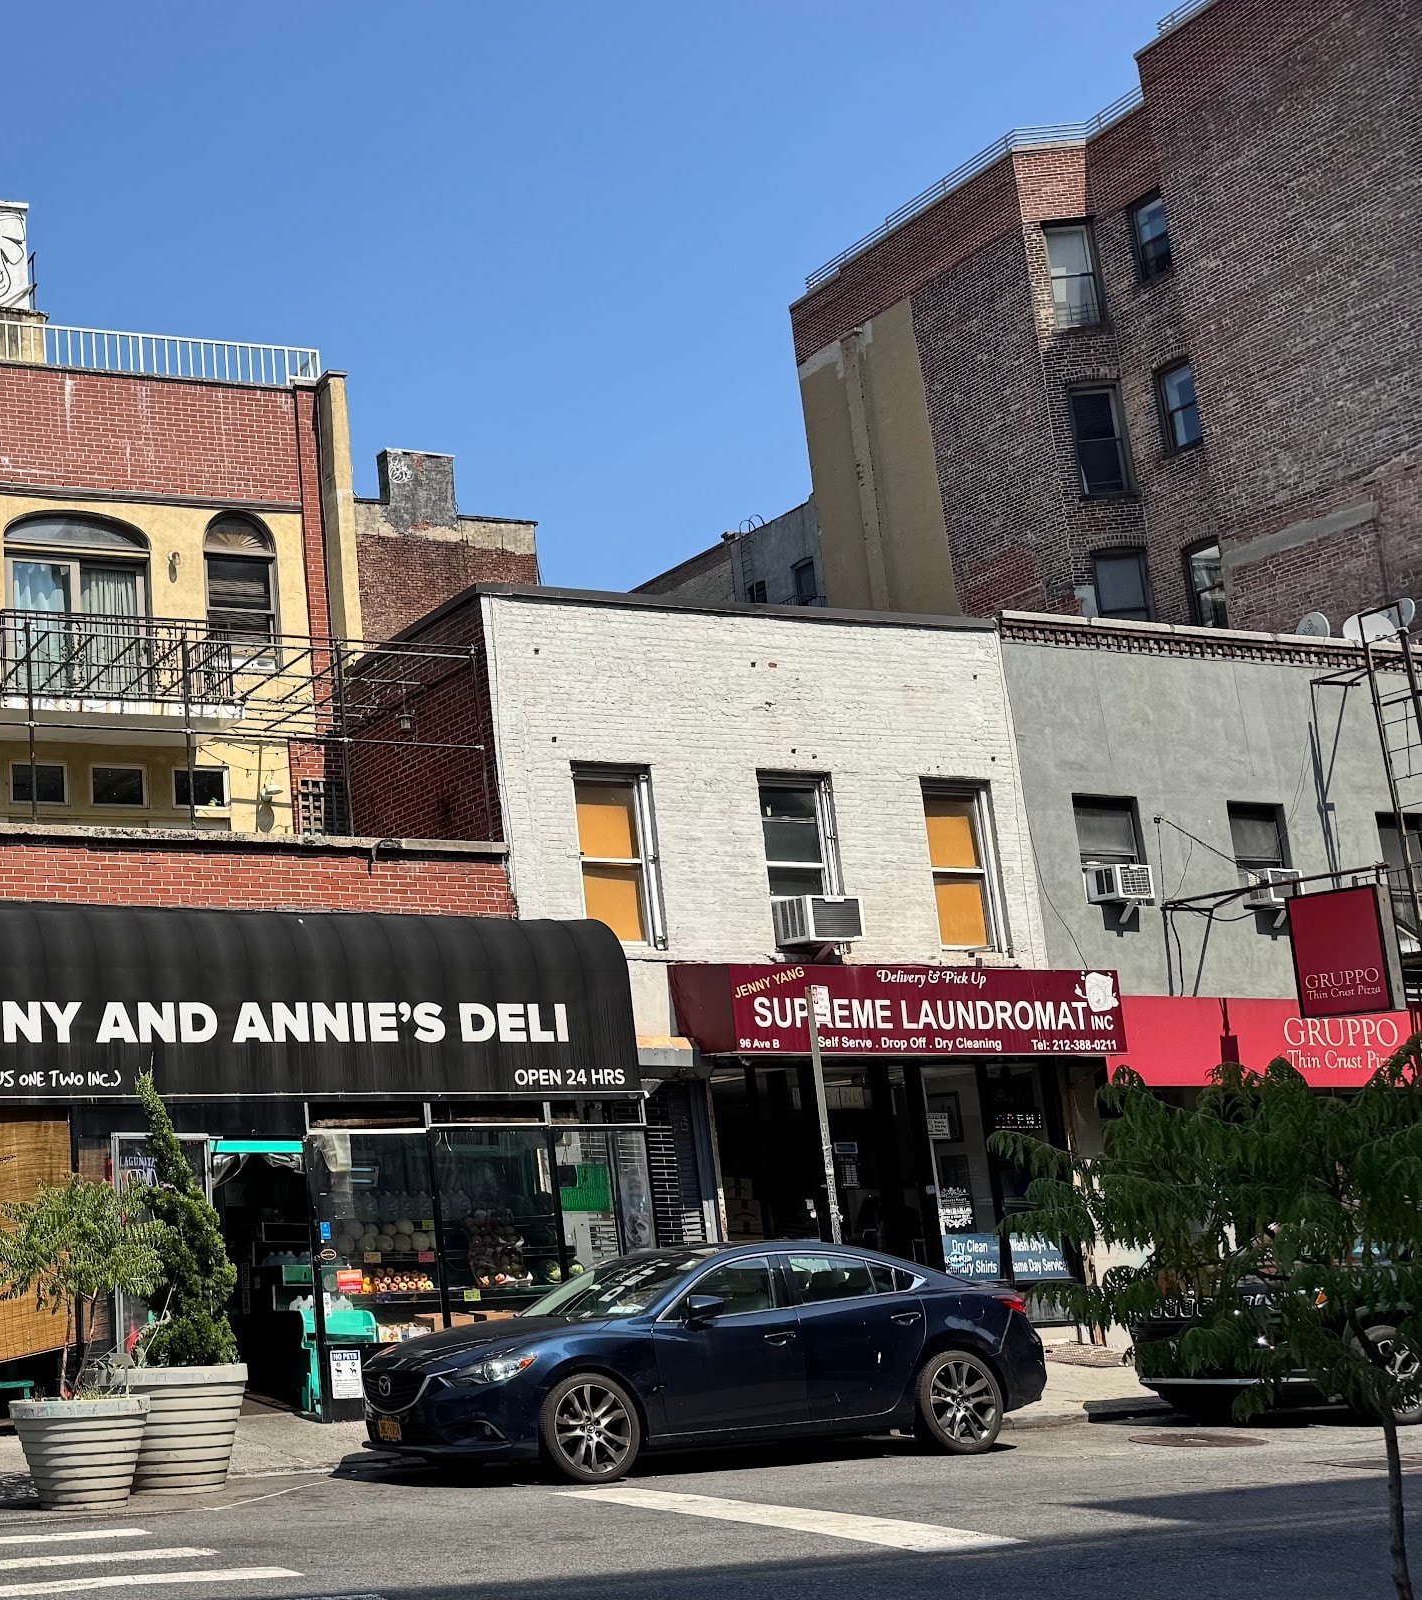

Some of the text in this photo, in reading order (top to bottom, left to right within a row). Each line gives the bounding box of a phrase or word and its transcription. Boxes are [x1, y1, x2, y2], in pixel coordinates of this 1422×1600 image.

[735, 966, 805, 999] JENNY YANG
[876, 969, 987, 989] Delivery & Pick Up
[1305, 968, 1379, 989] GRUPPO
[1307, 984, 1381, 1000] Thin Crust Pizza
[96, 1001, 218, 1044] AND
[232, 1001, 445, 1044] ANNIE'S
[459, 1003, 570, 1043] DELI
[900, 1000, 1087, 1030] LAUNDROMAT
[1091, 1015, 1114, 1030] INC
[1283, 1017, 1399, 1047] GRUPPO
[739, 1039, 780, 1048] 96 Ave B
[818, 1036, 1002, 1052] Self Serve Drop Off Dry Cleaning
[1031, 1040, 1117, 1051] Tel: 212-388-0211
[1287, 1050, 1321, 1069] Thin
[1325, 1050, 1362, 1069] Crust
[19, 1072, 46, 1088] ONE
[48, 1070, 84, 1088] TWO
[514, 1069, 626, 1086] OPEN 24 HRS
[952, 1239, 988, 1256] Dry Clean
[976, 1260, 998, 1274] Shirts
[1012, 1261, 1028, 1273] ame
[1028, 1260, 1042, 1275] Day
